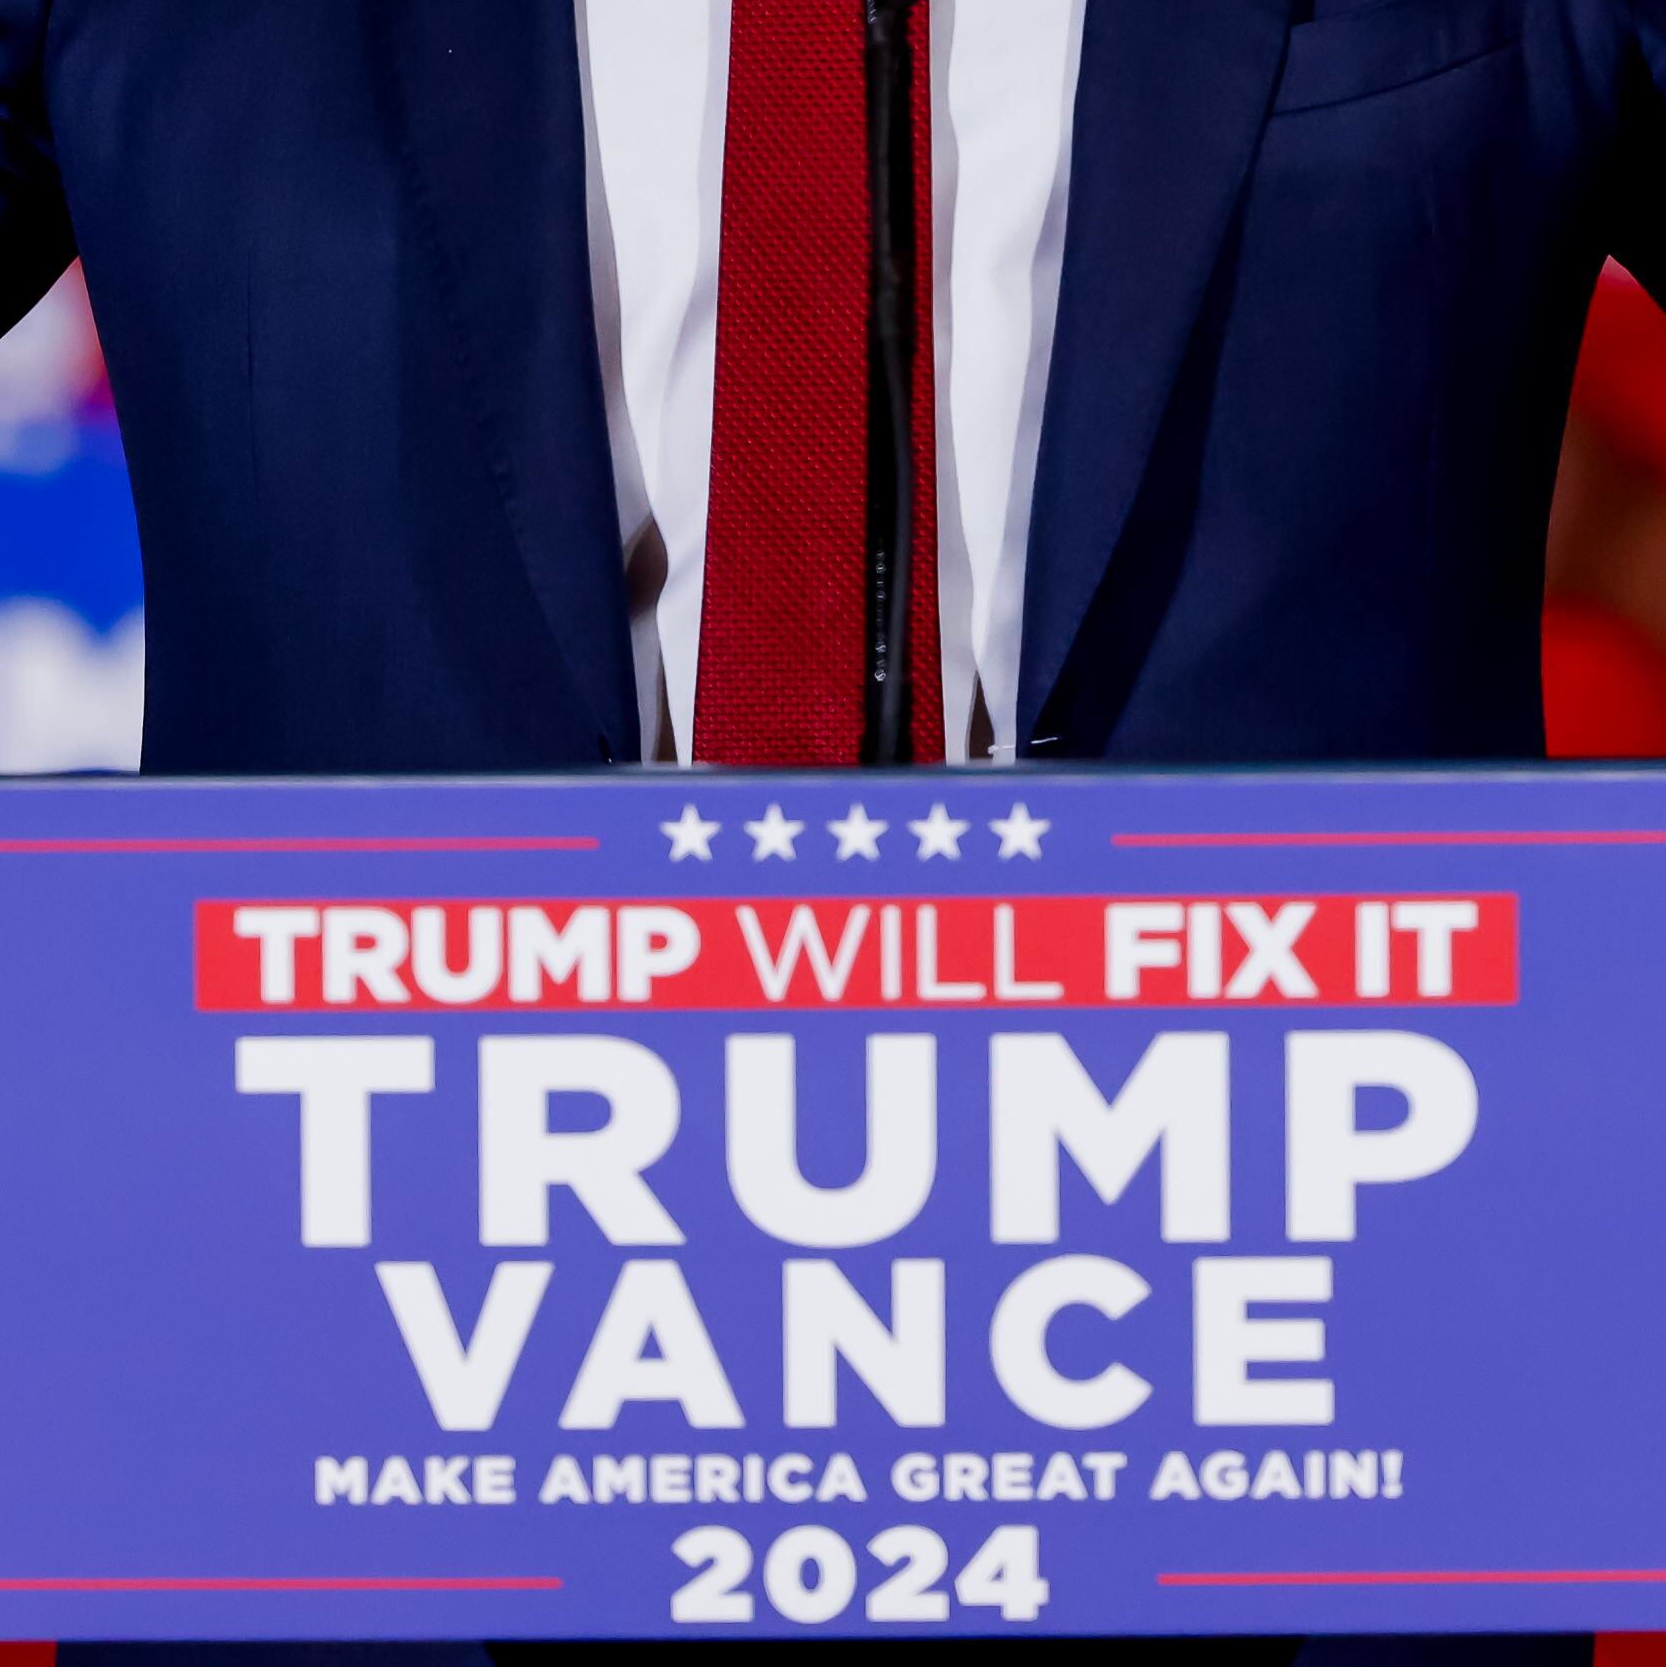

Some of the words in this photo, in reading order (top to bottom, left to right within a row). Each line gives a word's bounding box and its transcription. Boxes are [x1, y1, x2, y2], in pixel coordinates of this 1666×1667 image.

[233, 905, 701, 1004] TRUMP
[735, 904, 1064, 1001] WILL
[1104, 901, 1318, 1000] FIX
[1355, 900, 1479, 999] IT
[233, 1029, 1479, 1249] TRUMP
[374, 1253, 1335, 1431] VANCE
[314, 1454, 516, 1505] MAKE
[538, 1452, 868, 1504] AMERICA
[890, 1451, 1128, 1502] GREAT
[1149, 1449, 1403, 1501] AGAIN!
[669, 1523, 1050, 1625] 2024
